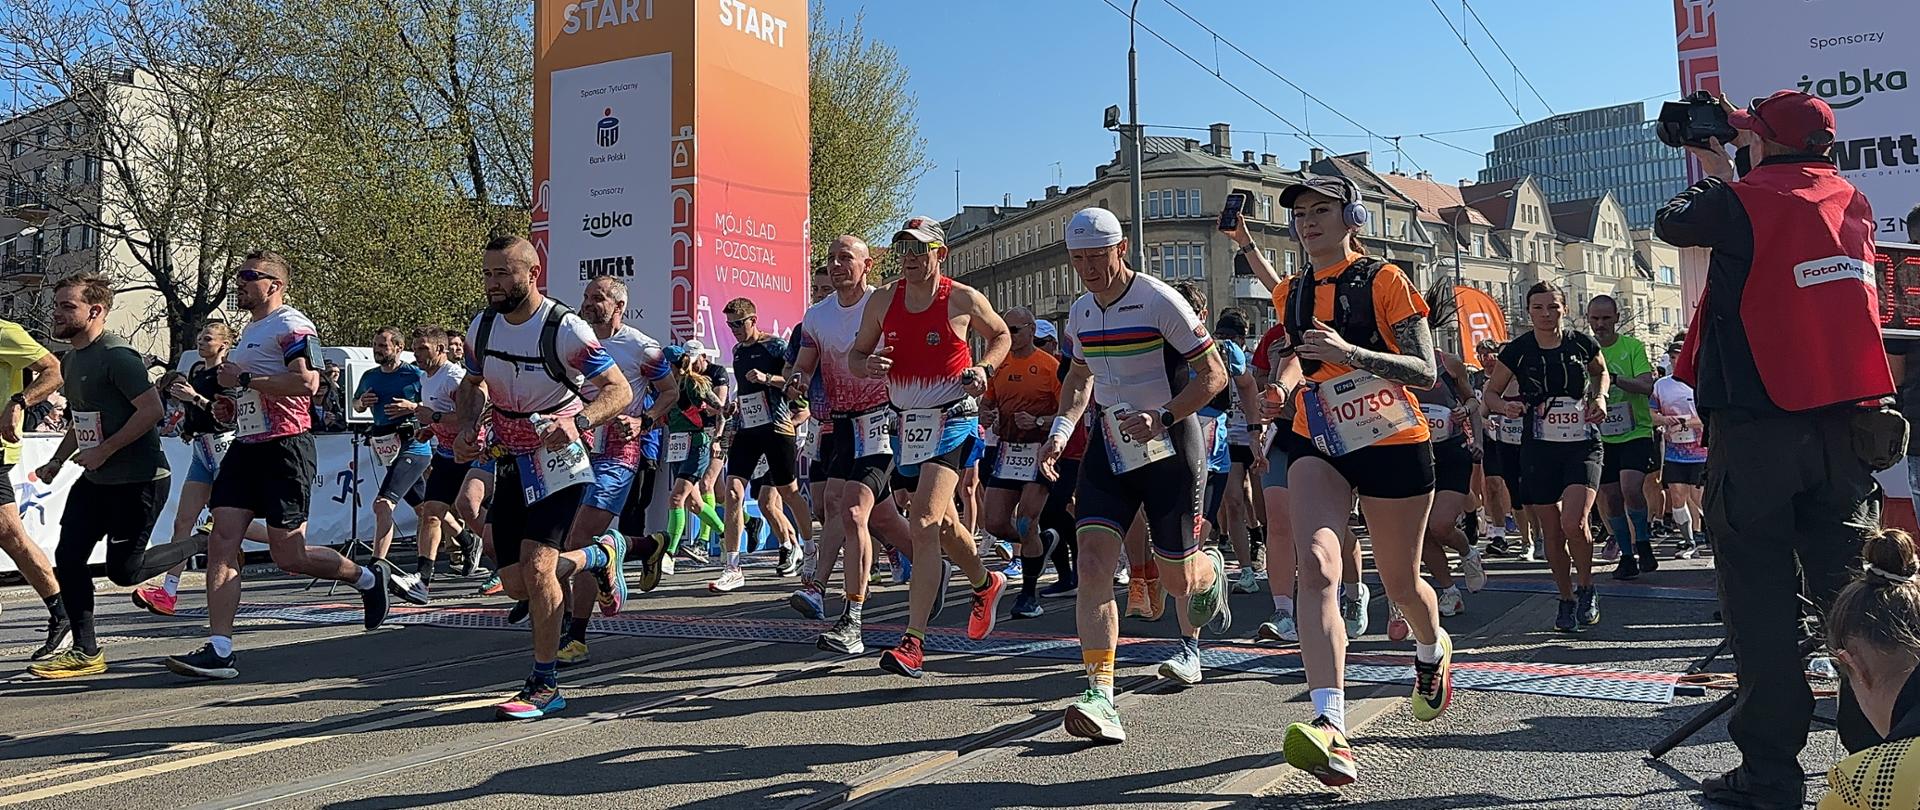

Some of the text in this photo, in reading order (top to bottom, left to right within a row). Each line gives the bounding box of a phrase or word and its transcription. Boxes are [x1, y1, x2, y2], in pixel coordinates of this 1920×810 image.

[562, 0, 654, 34] START
[718, 0, 788, 48] START
[1809, 31, 1885, 50] Sponsorzy
[580, 82, 639, 98] Sponsor Tytularny
[1796, 68, 1908, 98] żabka
[589, 152, 626, 164] Bank Polski
[590, 186, 624, 197] Sponsorzy
[582, 211, 633, 231] żabka
[715, 212, 777, 240] MÓJ ŚLAD
[715, 238, 777, 266] POZOSTAŁ
[586, 256, 635, 280] Witt
[715, 264, 792, 293] W POZNANIU
[1331, 388, 1395, 423] 10730
[1356, 415, 1383, 427] Karolina
[1428, 418, 1444, 429] 50
[1548, 412, 1579, 424] 8138
[904, 428, 933, 443] 1627
[547, 448, 584, 472] 95
[1006, 456, 1035, 466] 13339
